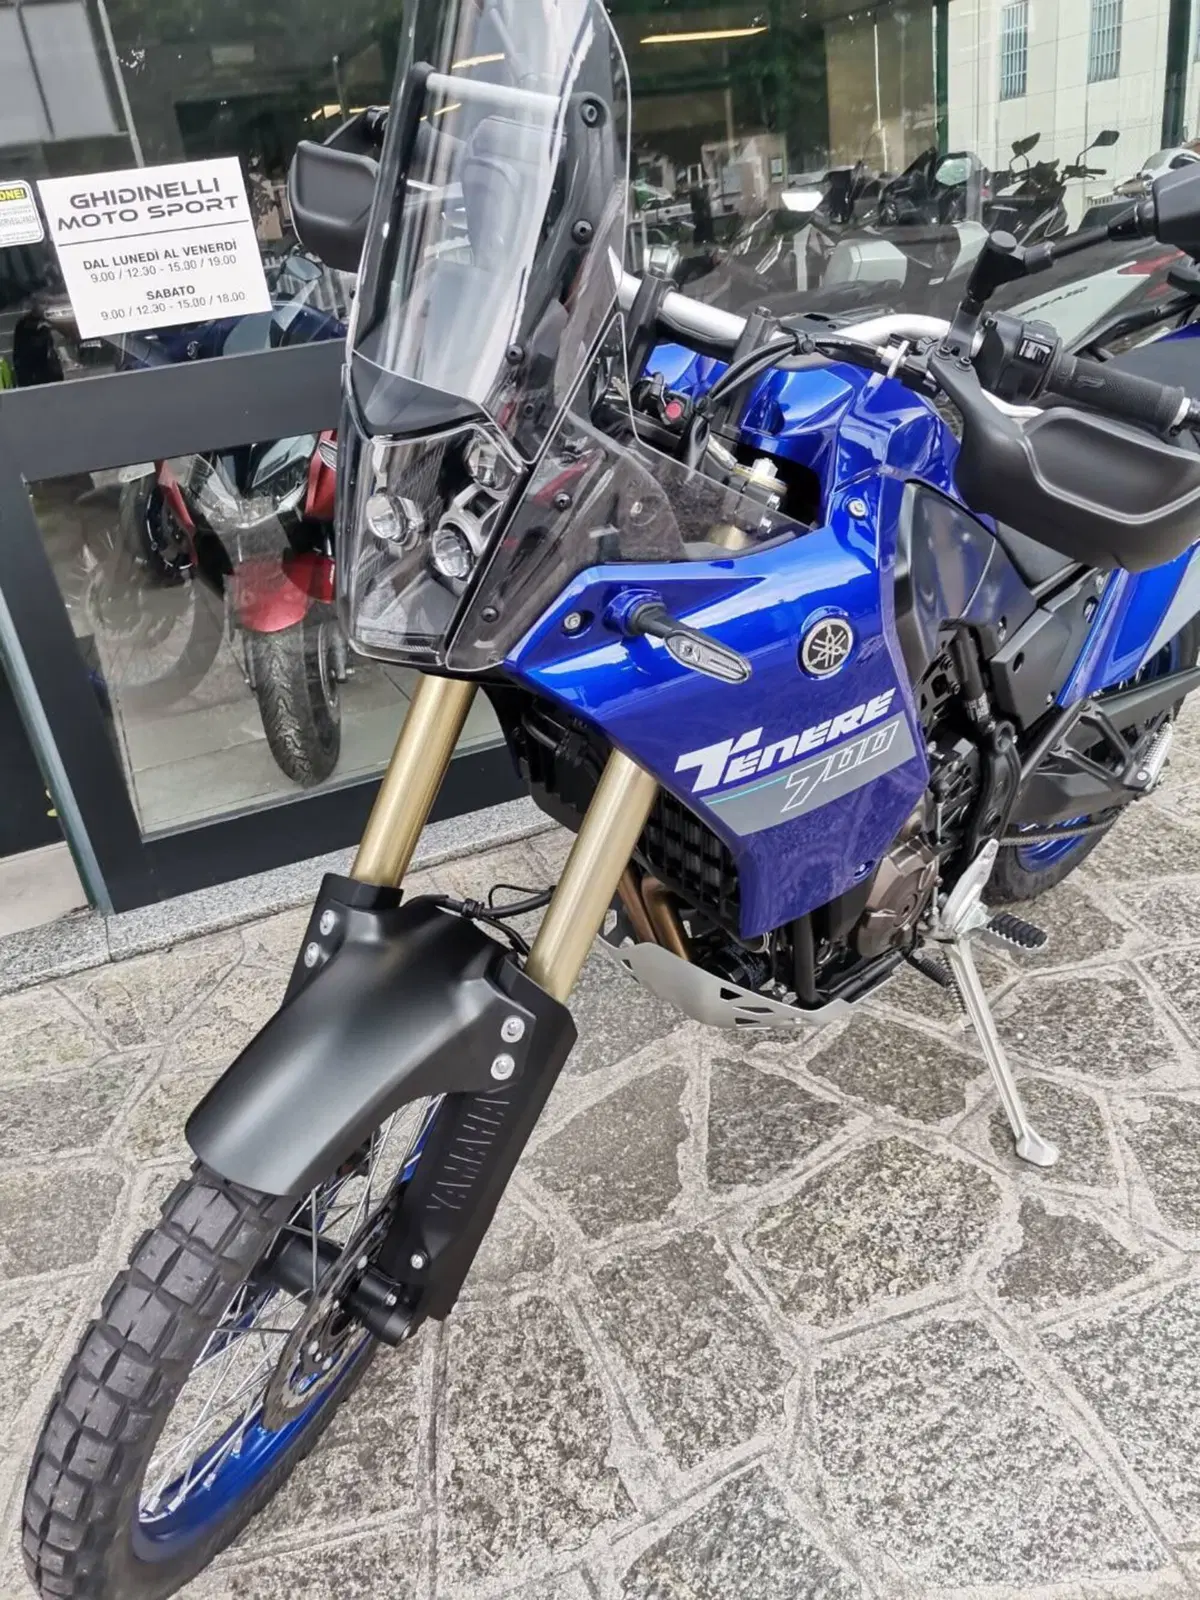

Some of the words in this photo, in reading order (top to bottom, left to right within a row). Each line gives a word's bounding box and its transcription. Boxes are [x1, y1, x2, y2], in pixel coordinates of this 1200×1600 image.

[69, 177, 220, 210] GHIDINELLI
[57, 208, 139, 231] MOTO
[147, 195, 239, 219] SPORT
[83, 258, 109, 270] DAL
[112, 248, 160, 266] LUNEDÌ
[163, 249, 180, 259] AL
[182, 240, 237, 256] VENERDÌ
[90, 271, 115, 283] 9.00
[127, 265, 157, 279] 12.30
[208, 254, 237, 267] 19.00
[100, 308, 125, 321] 9.00
[136, 302, 166, 316] 12.30
[217, 291, 246, 304] 18.00
[146, 285, 196, 301] SABATO
[780, 719, 900, 813] 700
[426, 1097, 511, 1209] YAMAHA
